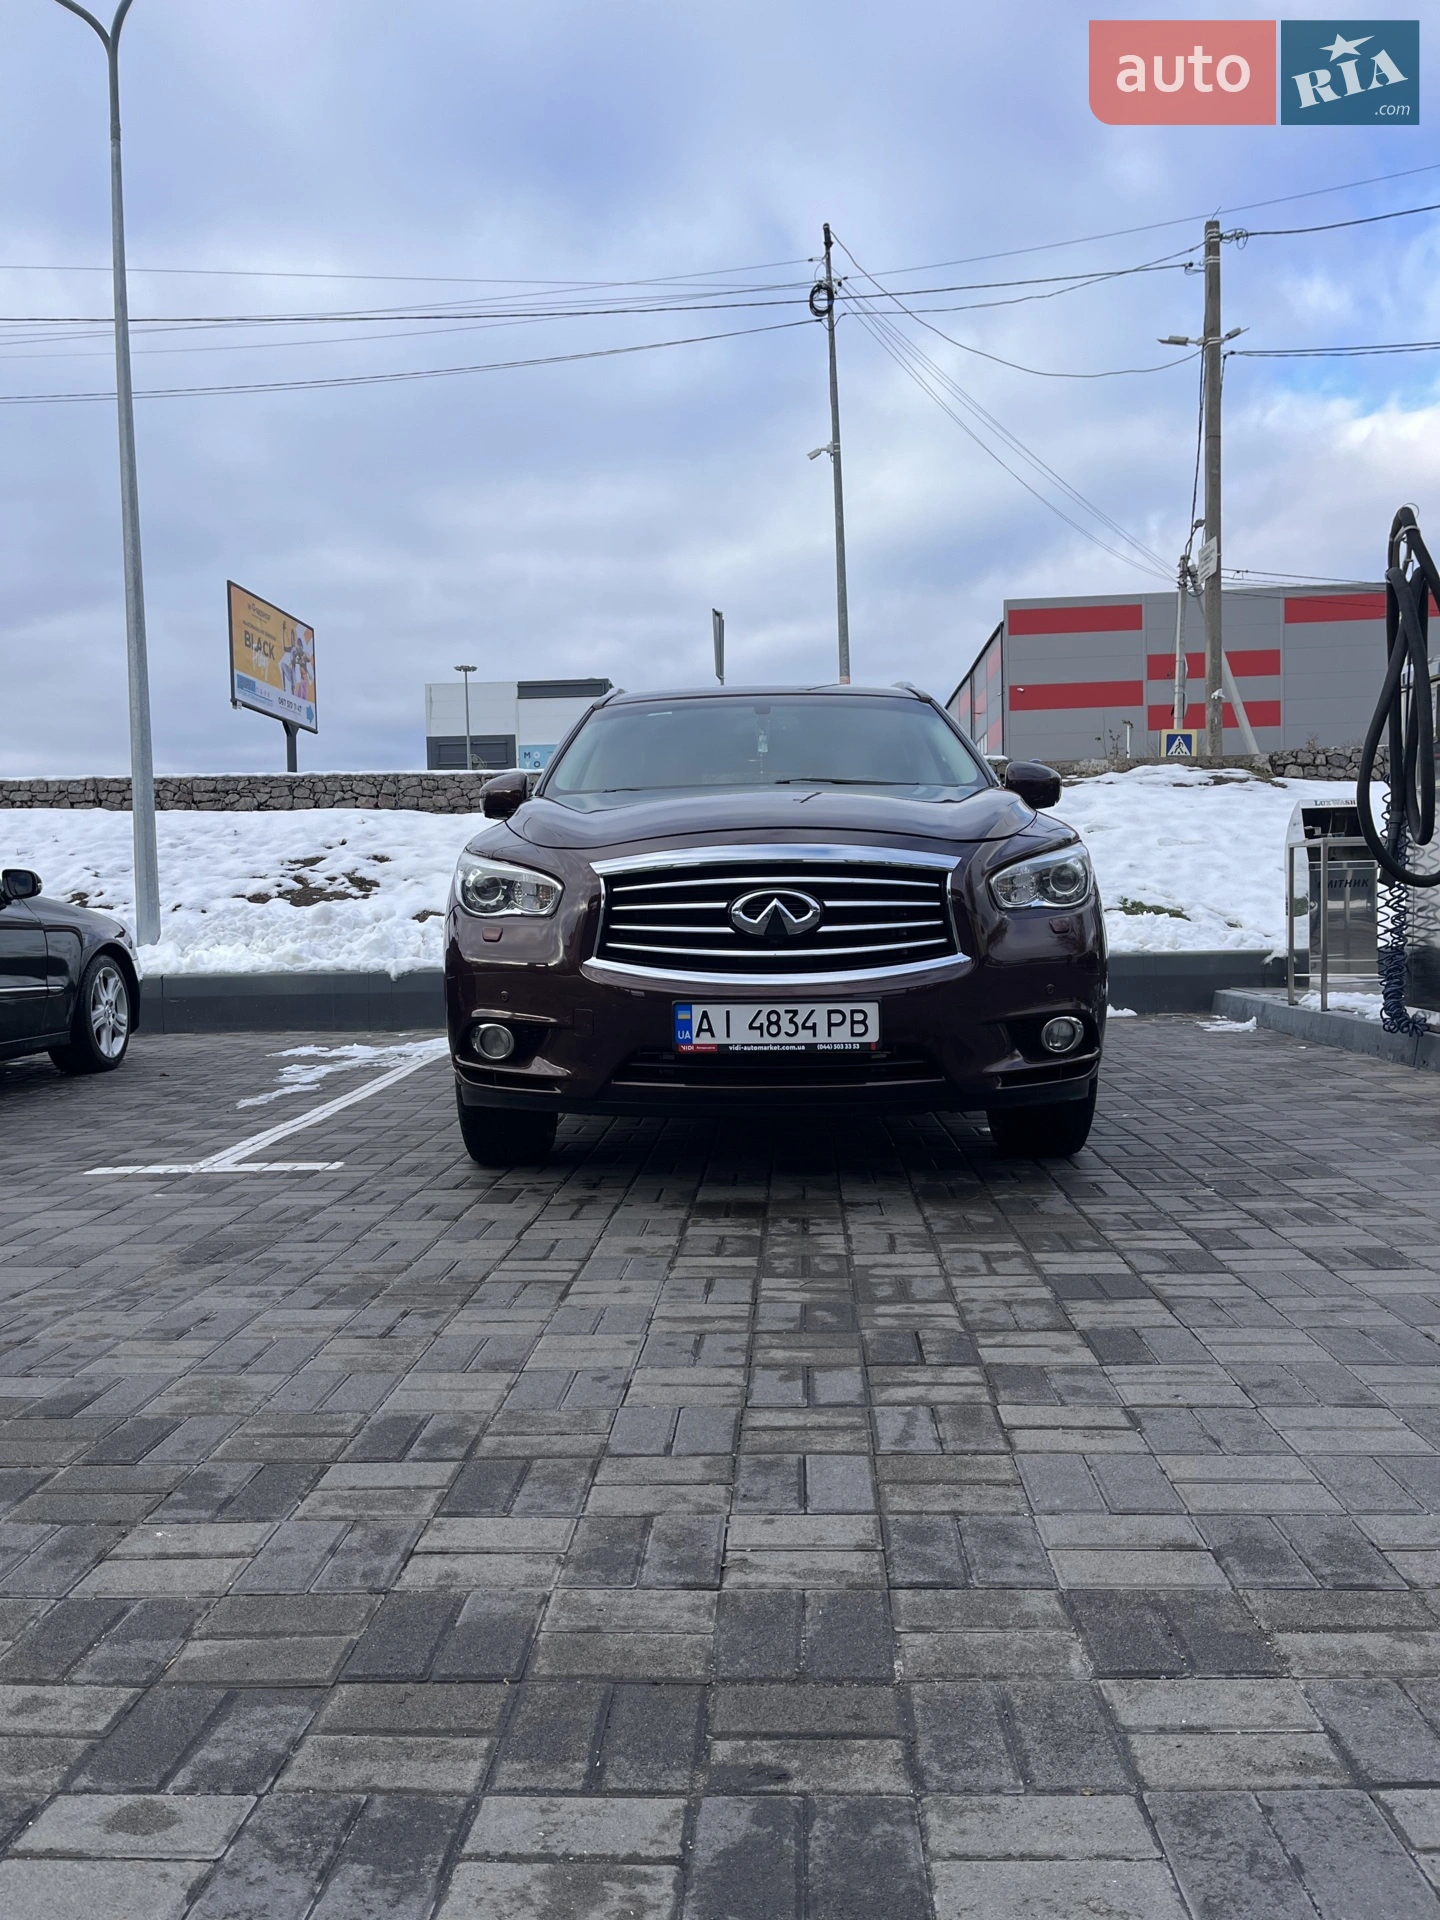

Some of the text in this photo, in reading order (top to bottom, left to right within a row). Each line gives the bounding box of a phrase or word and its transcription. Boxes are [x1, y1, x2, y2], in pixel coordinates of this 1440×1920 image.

[244, 630, 275, 660] BLACK
[678, 1031, 691, 1040] UA
[695, 1008, 869, 1038] AI 4834 PB
